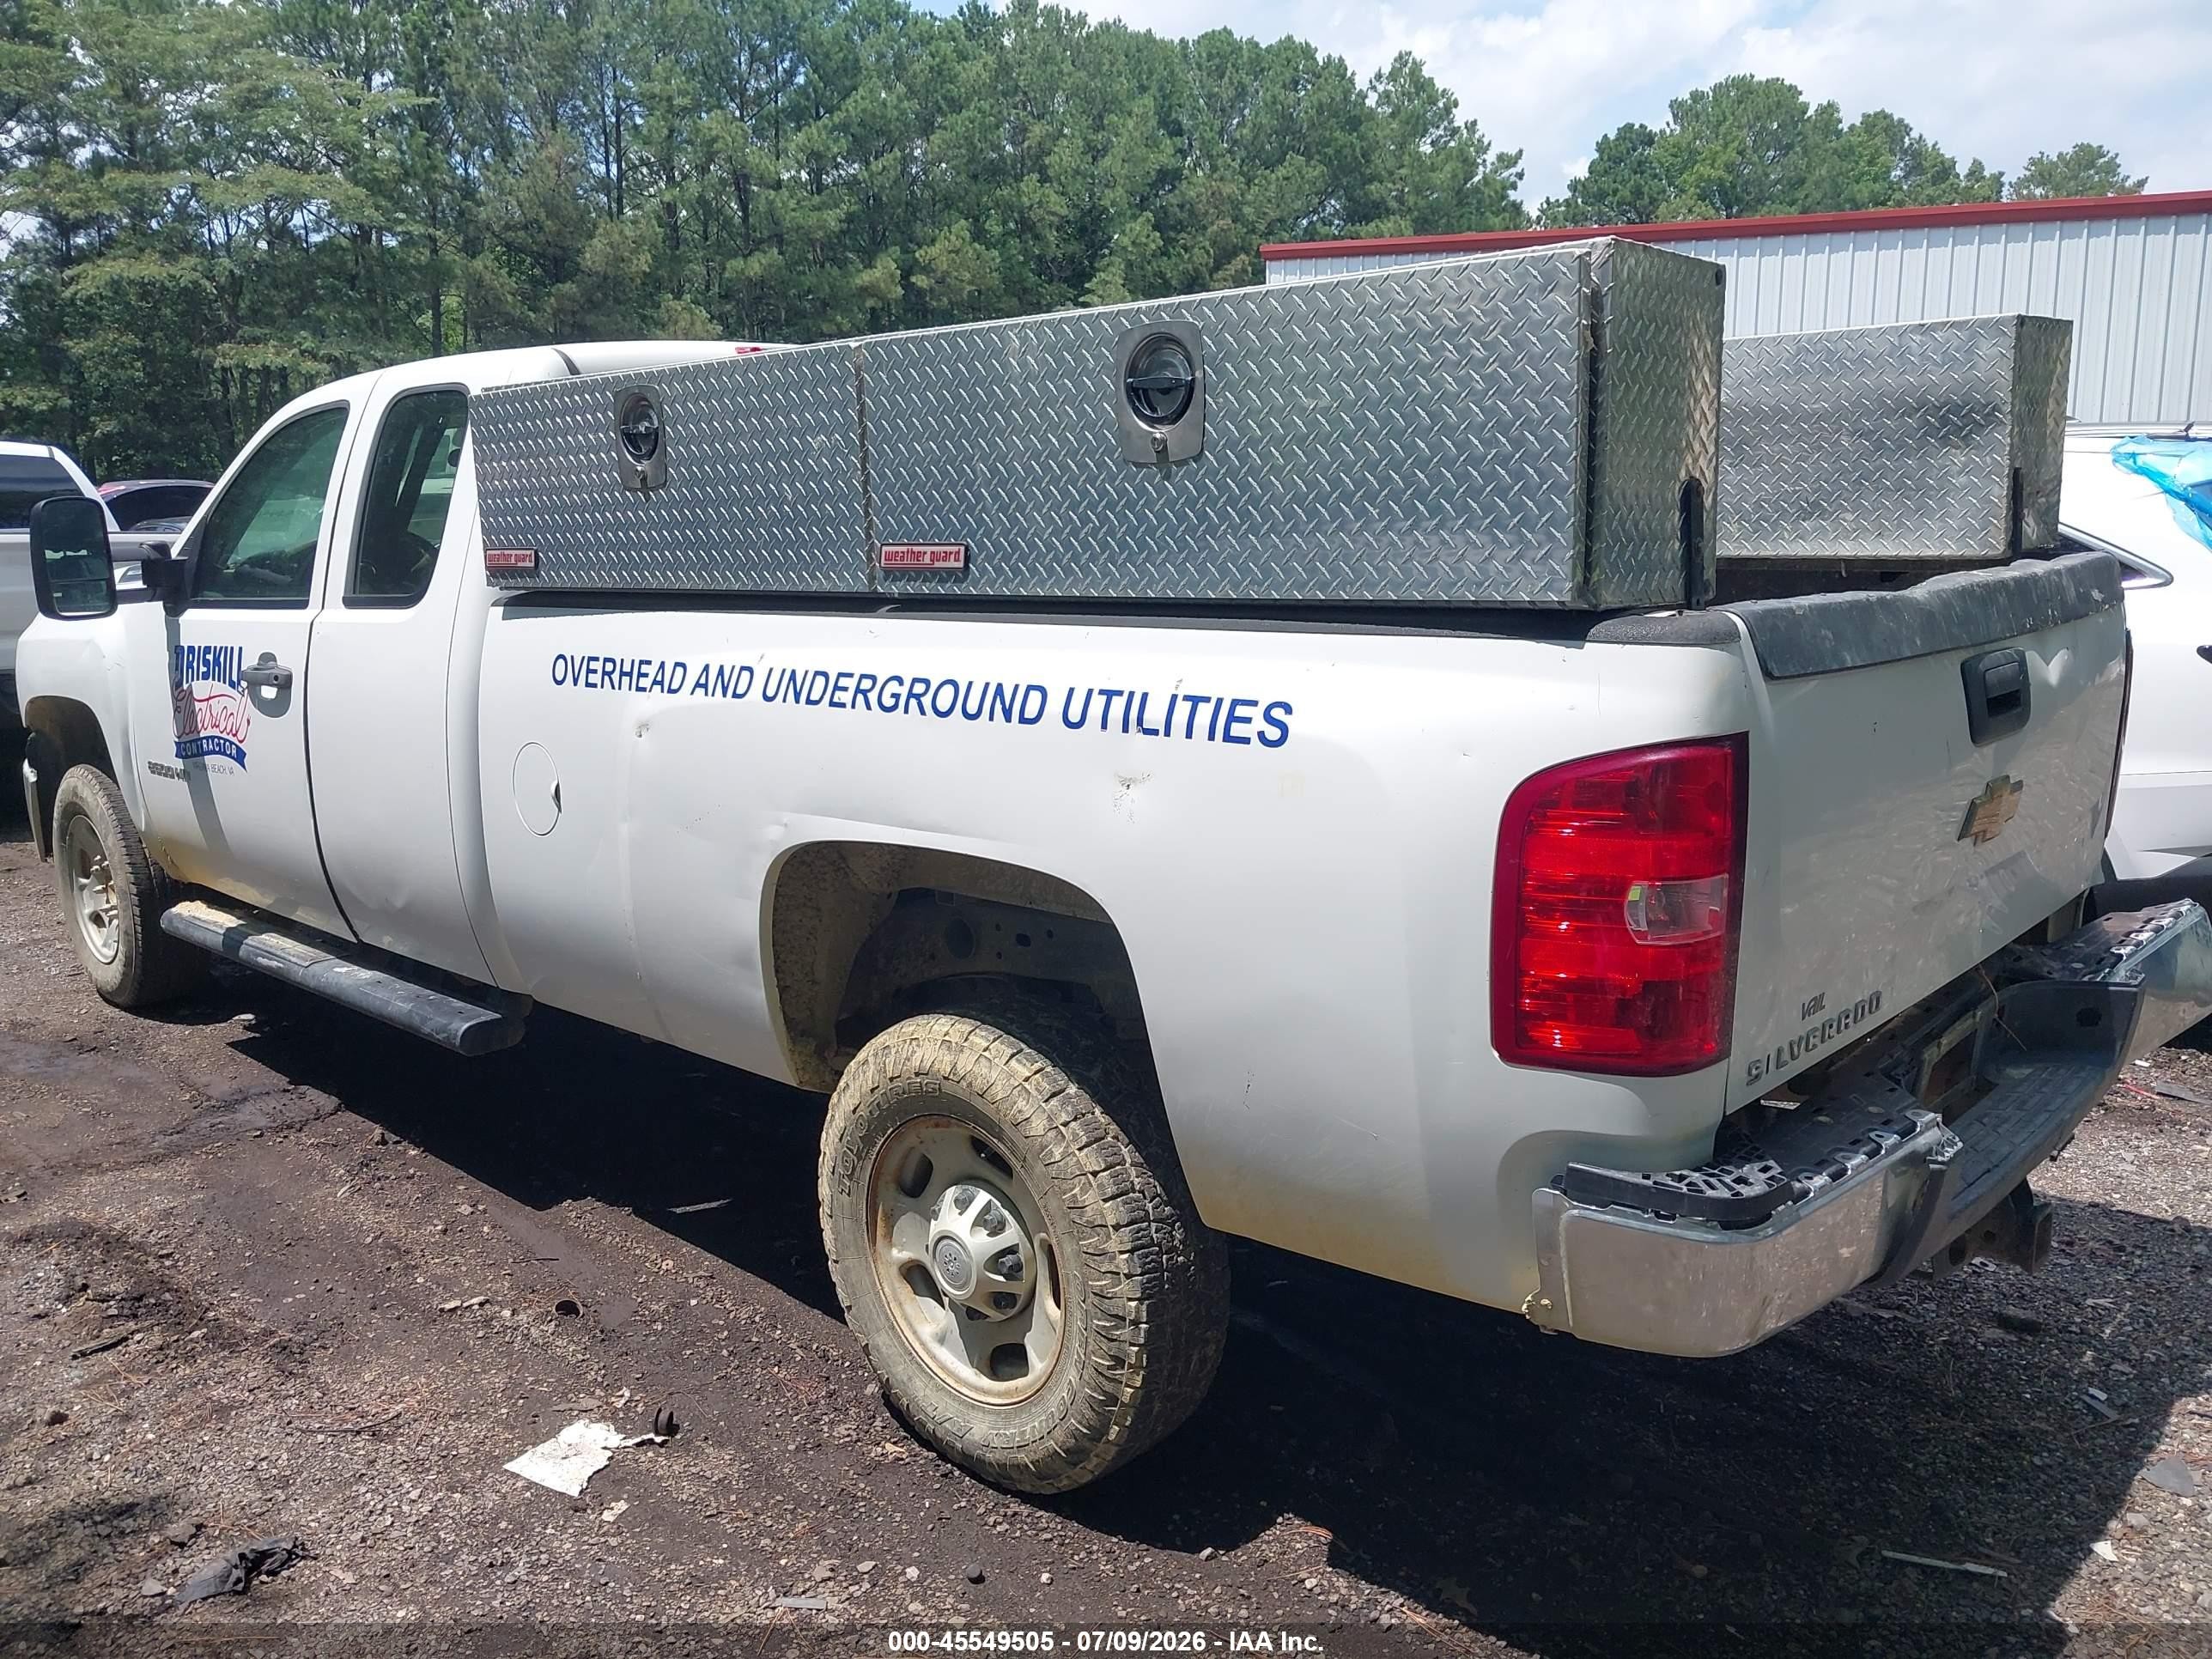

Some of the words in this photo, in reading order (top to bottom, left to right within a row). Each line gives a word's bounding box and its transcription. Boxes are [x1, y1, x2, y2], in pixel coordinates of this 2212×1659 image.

[487, 551, 513, 563] weather
[514, 551, 533, 563] guard
[883, 547, 927, 562] weather
[929, 547, 961, 565] guard
[173, 645, 245, 697] DRISKILL
[551, 653, 688, 695] OVERHEAD
[690, 663, 755, 700] AND
[761, 667, 1048, 725] UNDERGROUND
[1061, 686, 1293, 749] UTILITIES
[173, 675, 251, 744] Electrical
[180, 738, 237, 759] CONTRACTOR
[1746, 990, 1883, 1087] SILVERADO
[837, 1111, 868, 1198] TOYO
[867, 1079, 941, 1118] TIRES
